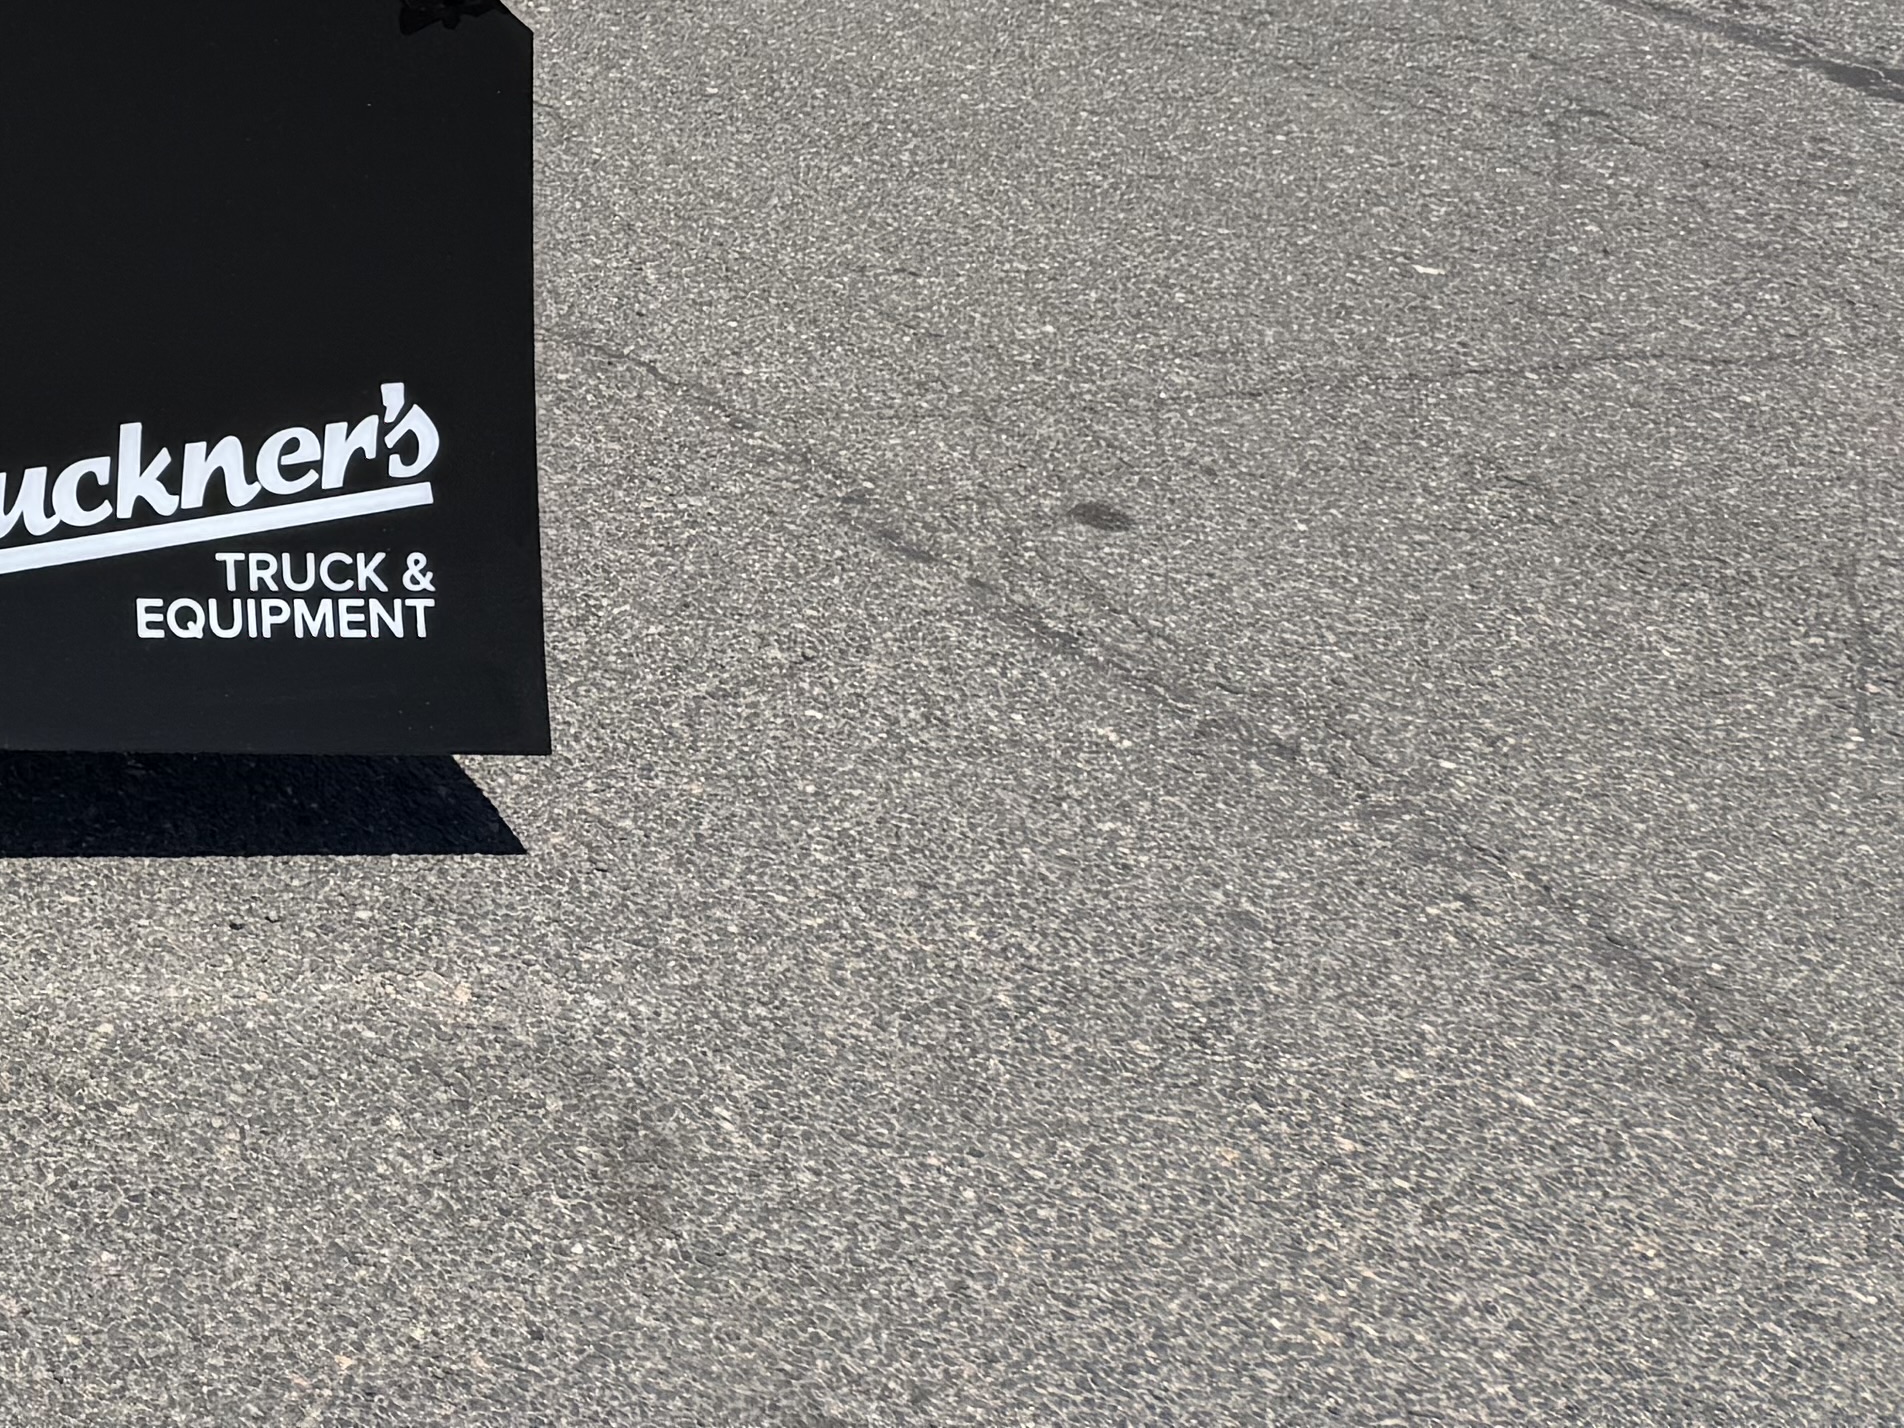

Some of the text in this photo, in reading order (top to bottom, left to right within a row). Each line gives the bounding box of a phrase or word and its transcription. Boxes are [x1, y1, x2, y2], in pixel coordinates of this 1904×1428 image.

[214, 551, 437, 593] TRUCK &
[135, 596, 437, 640] EQUIPMENT
